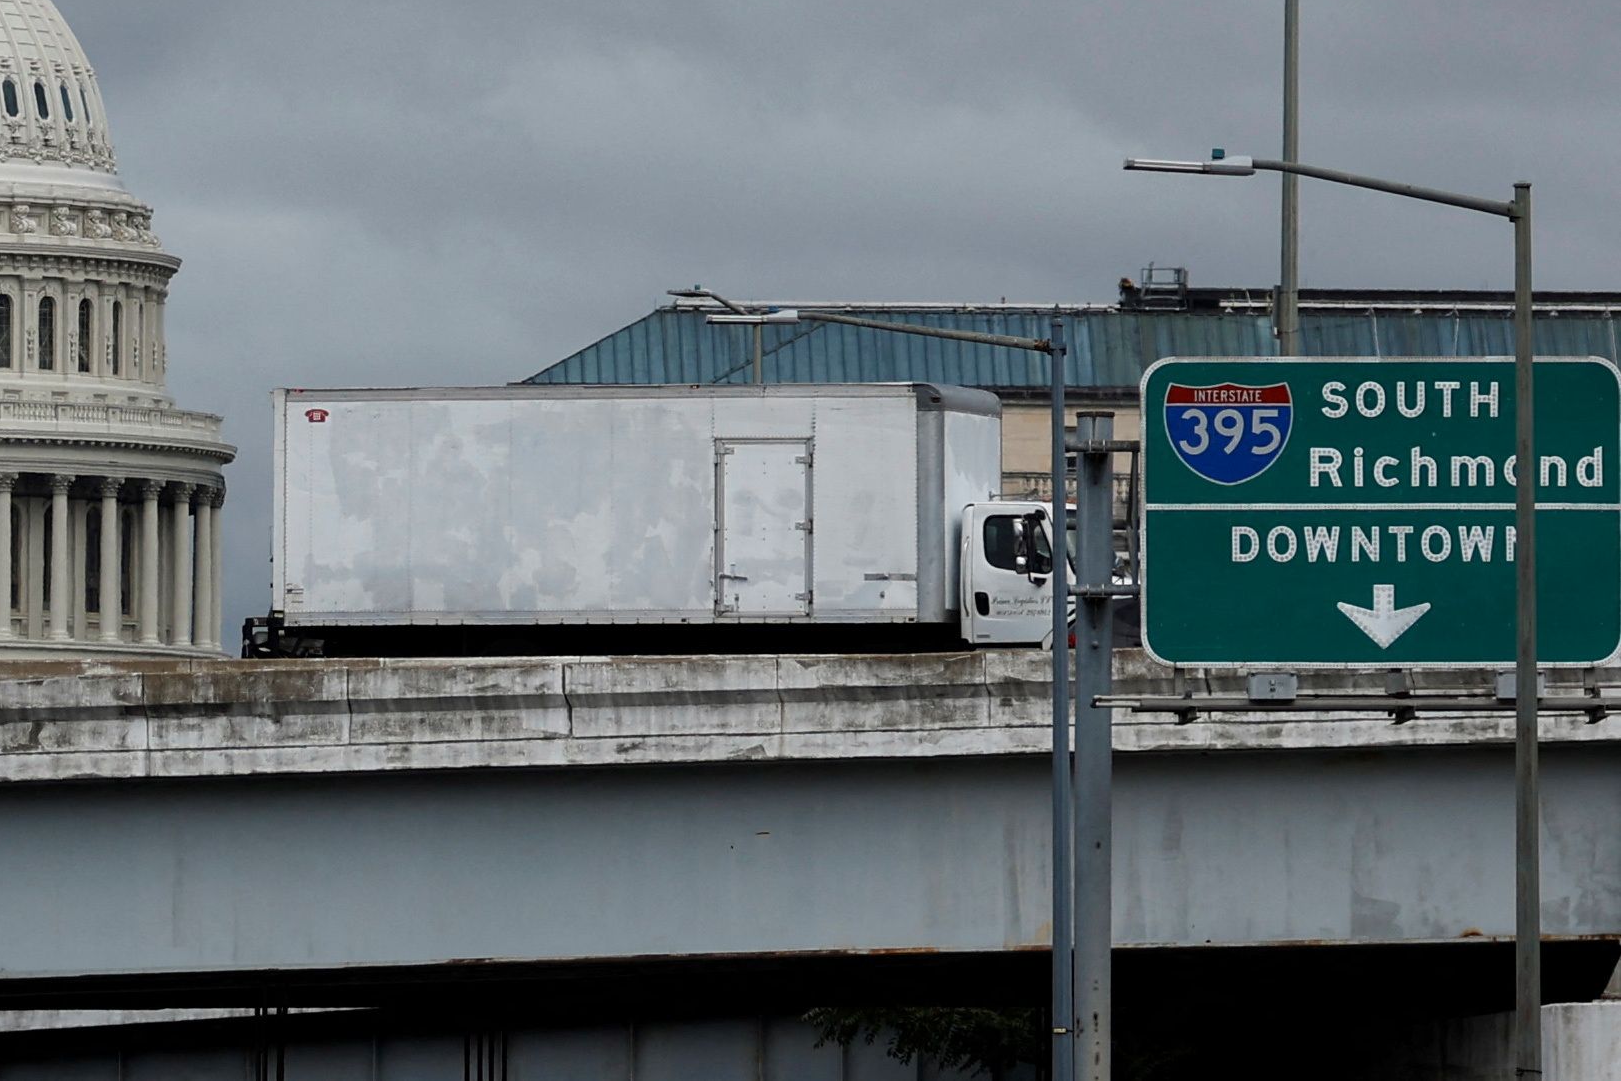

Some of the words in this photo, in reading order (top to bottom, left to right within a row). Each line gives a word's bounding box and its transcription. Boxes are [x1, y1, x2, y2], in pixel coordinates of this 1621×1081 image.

[1194, 390, 1262, 402] INTERSTATE
[1321, 381, 1499, 418] SOUTH
[1179, 408, 1281, 455] 395
